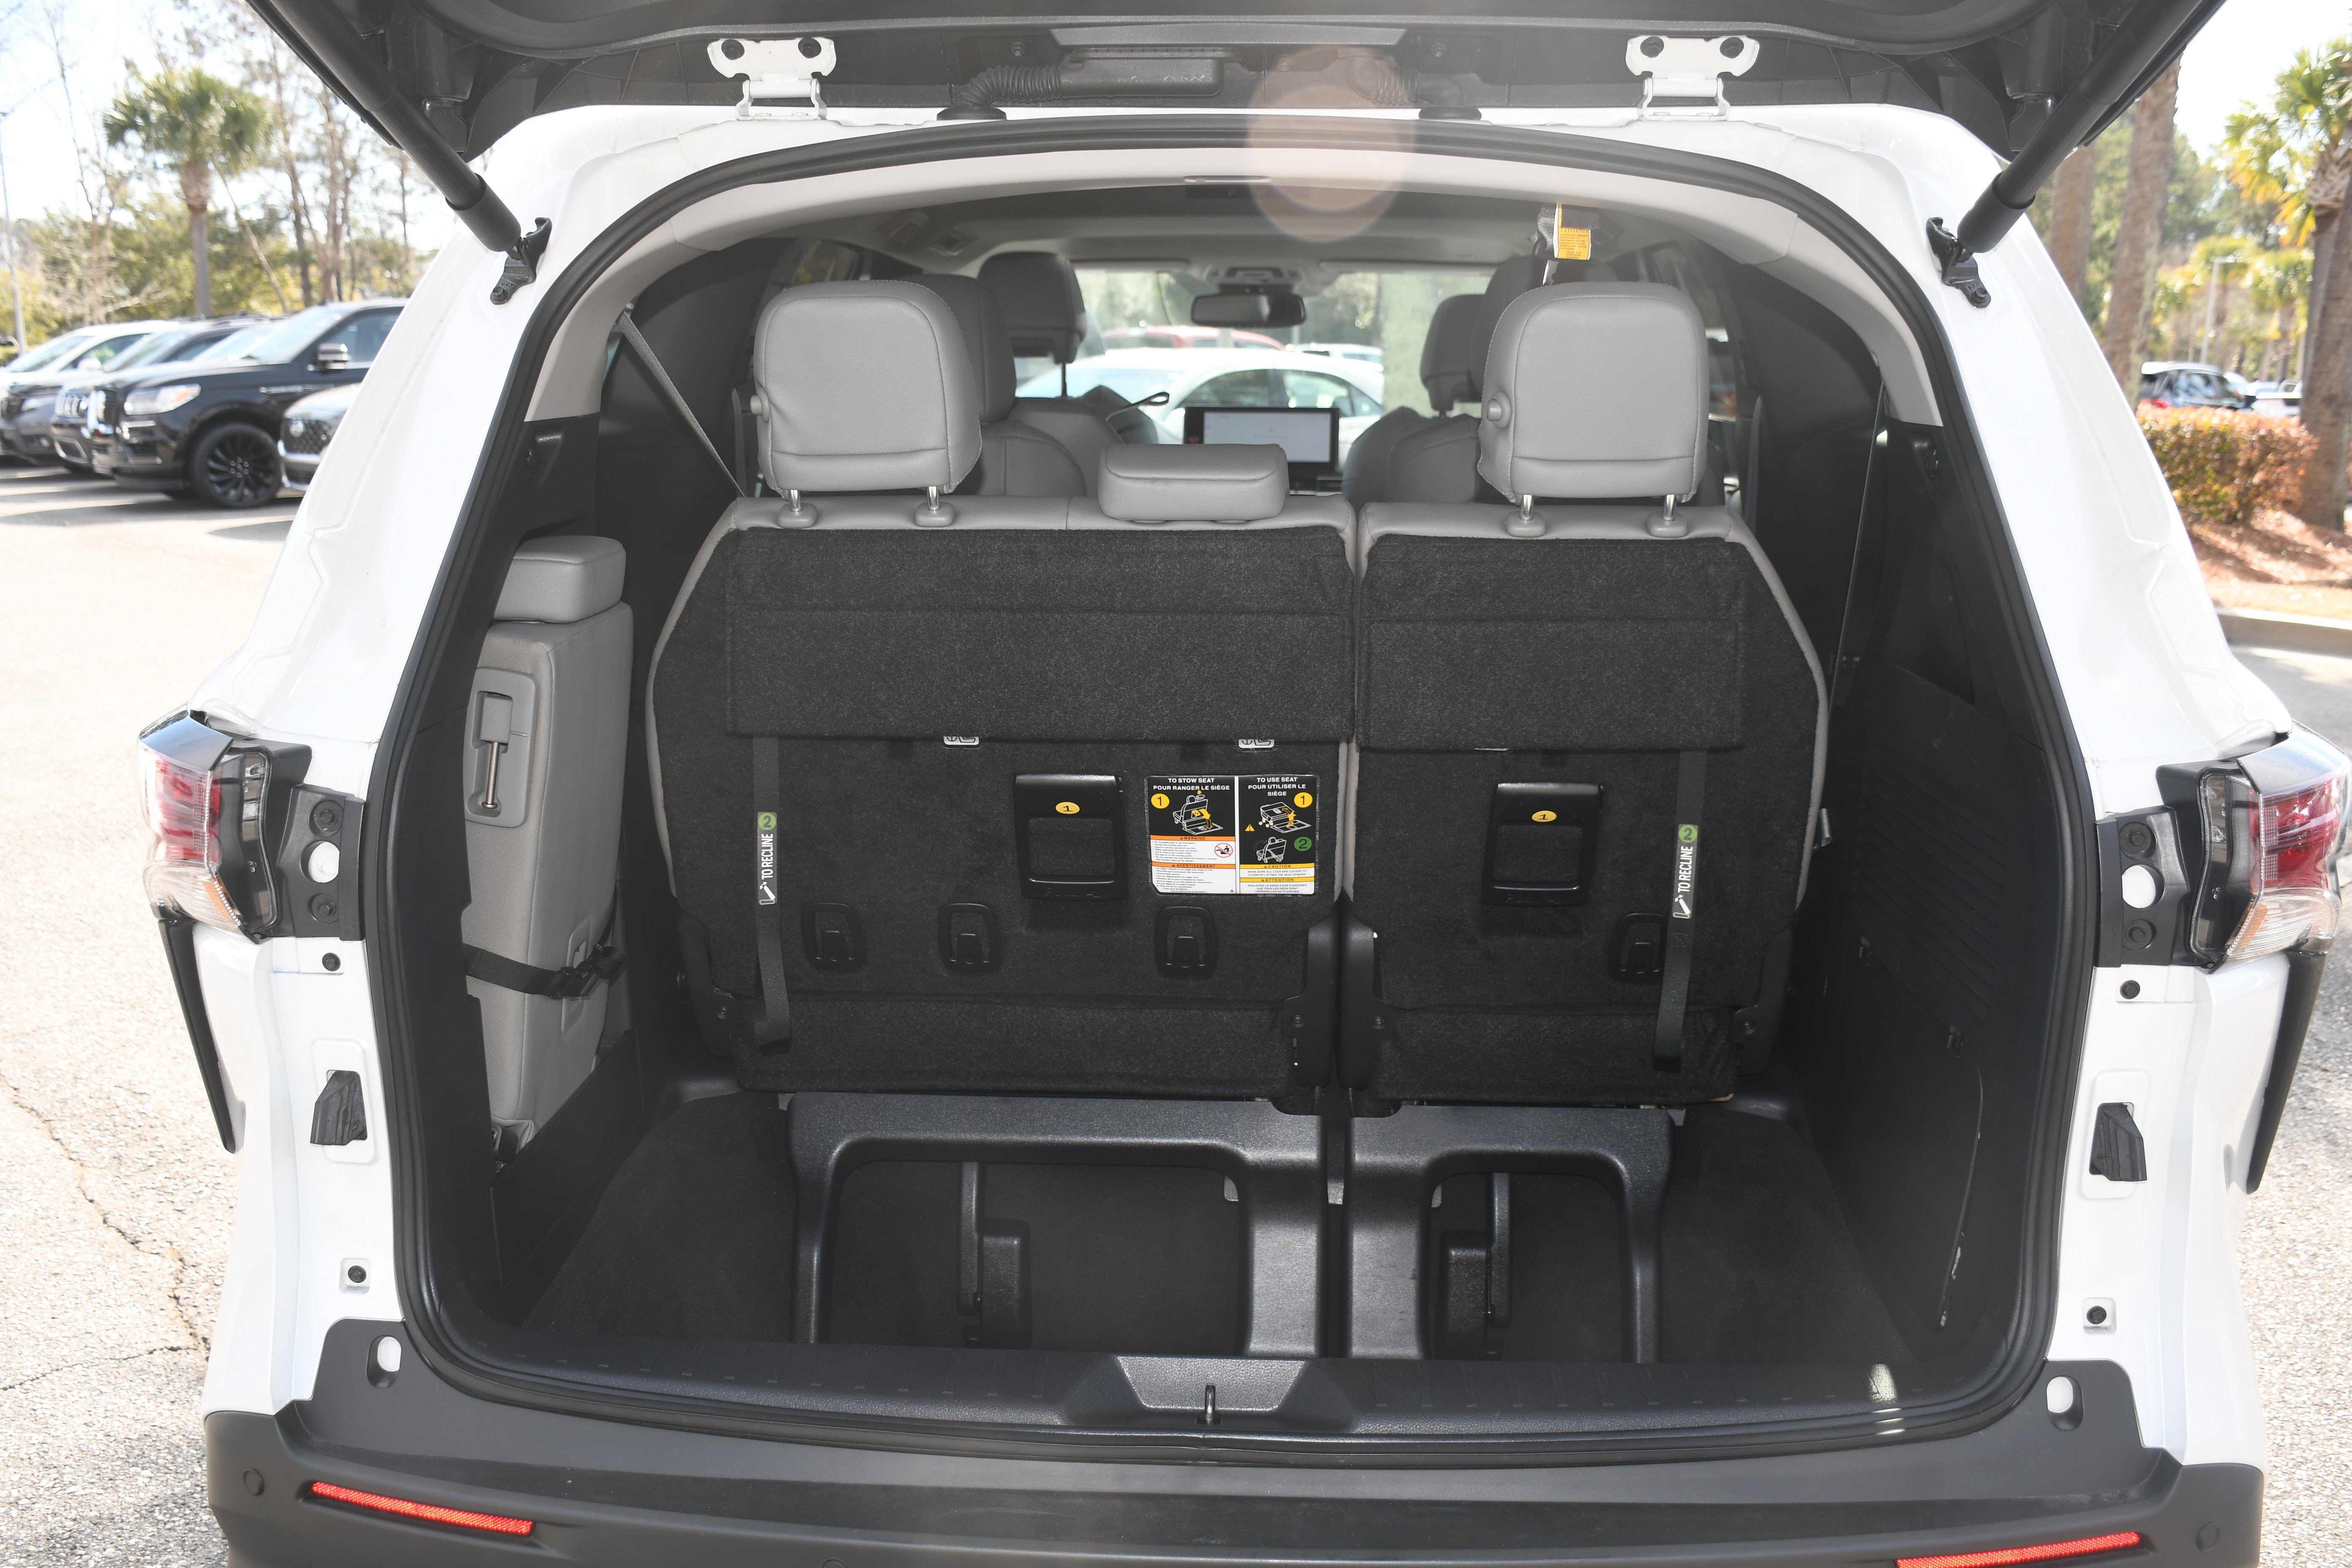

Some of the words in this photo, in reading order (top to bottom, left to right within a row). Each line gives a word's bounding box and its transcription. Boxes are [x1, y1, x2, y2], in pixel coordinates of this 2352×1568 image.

[1157, 796, 1162, 806] 1
[1300, 795, 1305, 805] 1
[763, 815, 772, 828] 2
[1684, 828, 1692, 841] 2
[1299, 839, 1307, 849] 2
[762, 833, 773, 868] RECLINE
[1679, 846, 1693, 881] RECLINE
[762, 868, 773, 880] TO
[1678, 882, 1690, 893] TO
